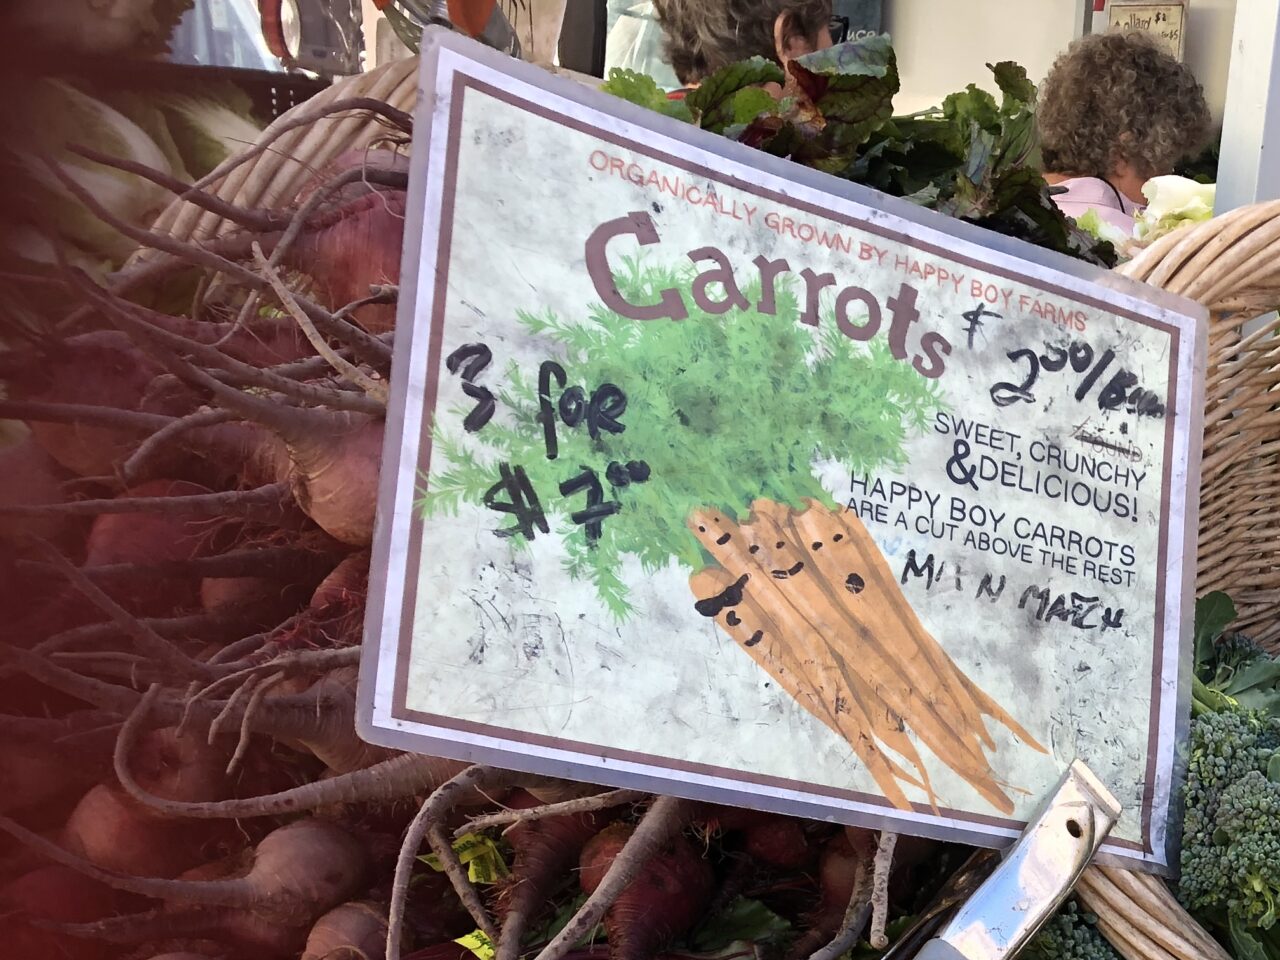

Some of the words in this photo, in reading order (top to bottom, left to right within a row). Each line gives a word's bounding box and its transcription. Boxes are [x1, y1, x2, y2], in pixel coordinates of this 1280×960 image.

[590, 150, 756, 225] ORGANICALLY
[765, 212, 852, 254] GROWN
[857, 240, 888, 264] BY
[895, 254, 964, 294] HAPPY
[970, 279, 1013, 305] BOY
[1019, 294, 1088, 332] FARMS
[585, 211, 952, 379] Carrots
[446, 343, 497, 433] 3
[934, 412, 1022, 460] SWEET,
[1030, 441, 1147, 491] CRUNCHY
[845, 498, 889, 524] ARE
[894, 511, 908, 531] A
[915, 516, 959, 541] CUT
[964, 530, 1034, 564] ABOVE
[1039, 549, 1078, 575] THE
[1083, 560, 1136, 588] REST
[850, 470, 940, 518] HAPPY
[950, 497, 1006, 533] BOY
[1014, 517, 1136, 566] CARROTS
